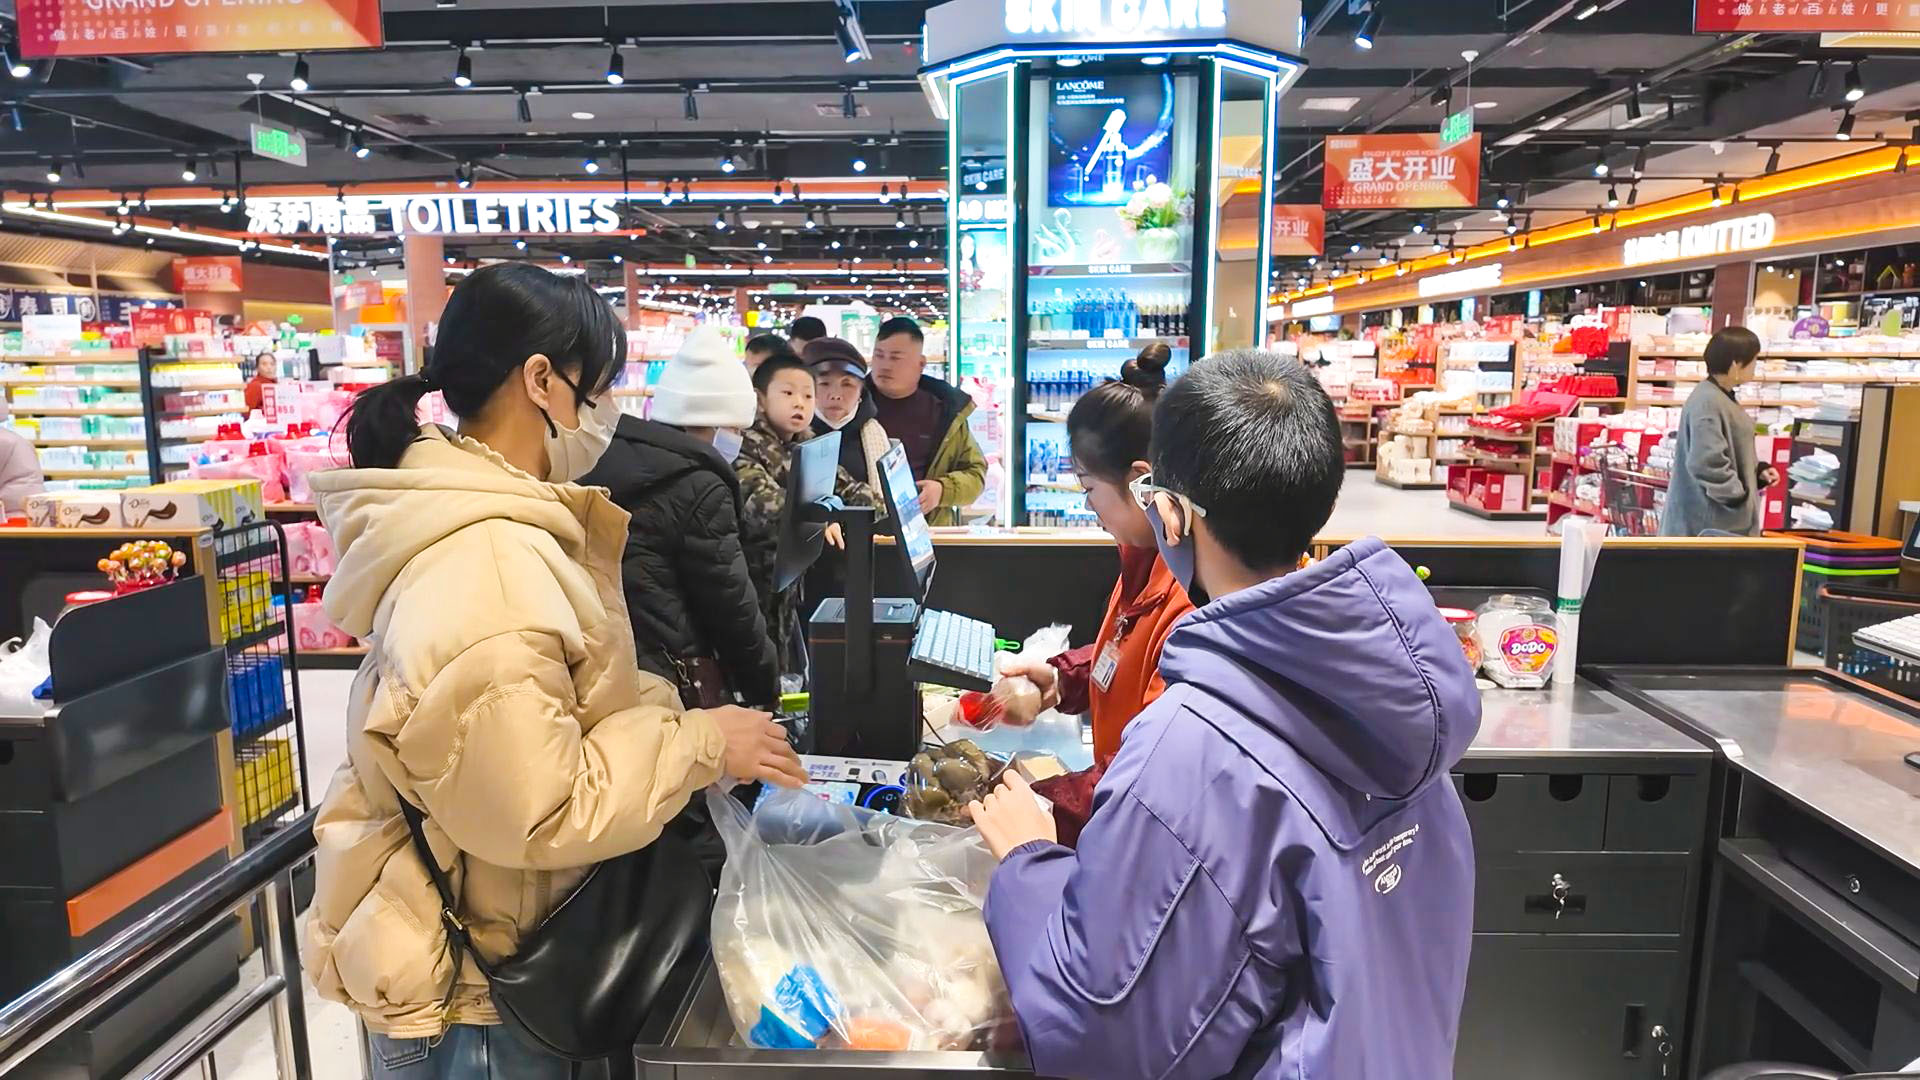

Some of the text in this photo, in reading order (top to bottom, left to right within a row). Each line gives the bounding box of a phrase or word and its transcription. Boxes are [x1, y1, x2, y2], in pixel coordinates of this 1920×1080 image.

[1110, 0, 1227, 32] CARE
[1348, 157, 1456, 182] 盛大开业
[1353, 181, 1449, 193] GRAND OPENING
[245, 199, 376, 234] 洗护用品
[378, 197, 620, 234] TOILETRIES
